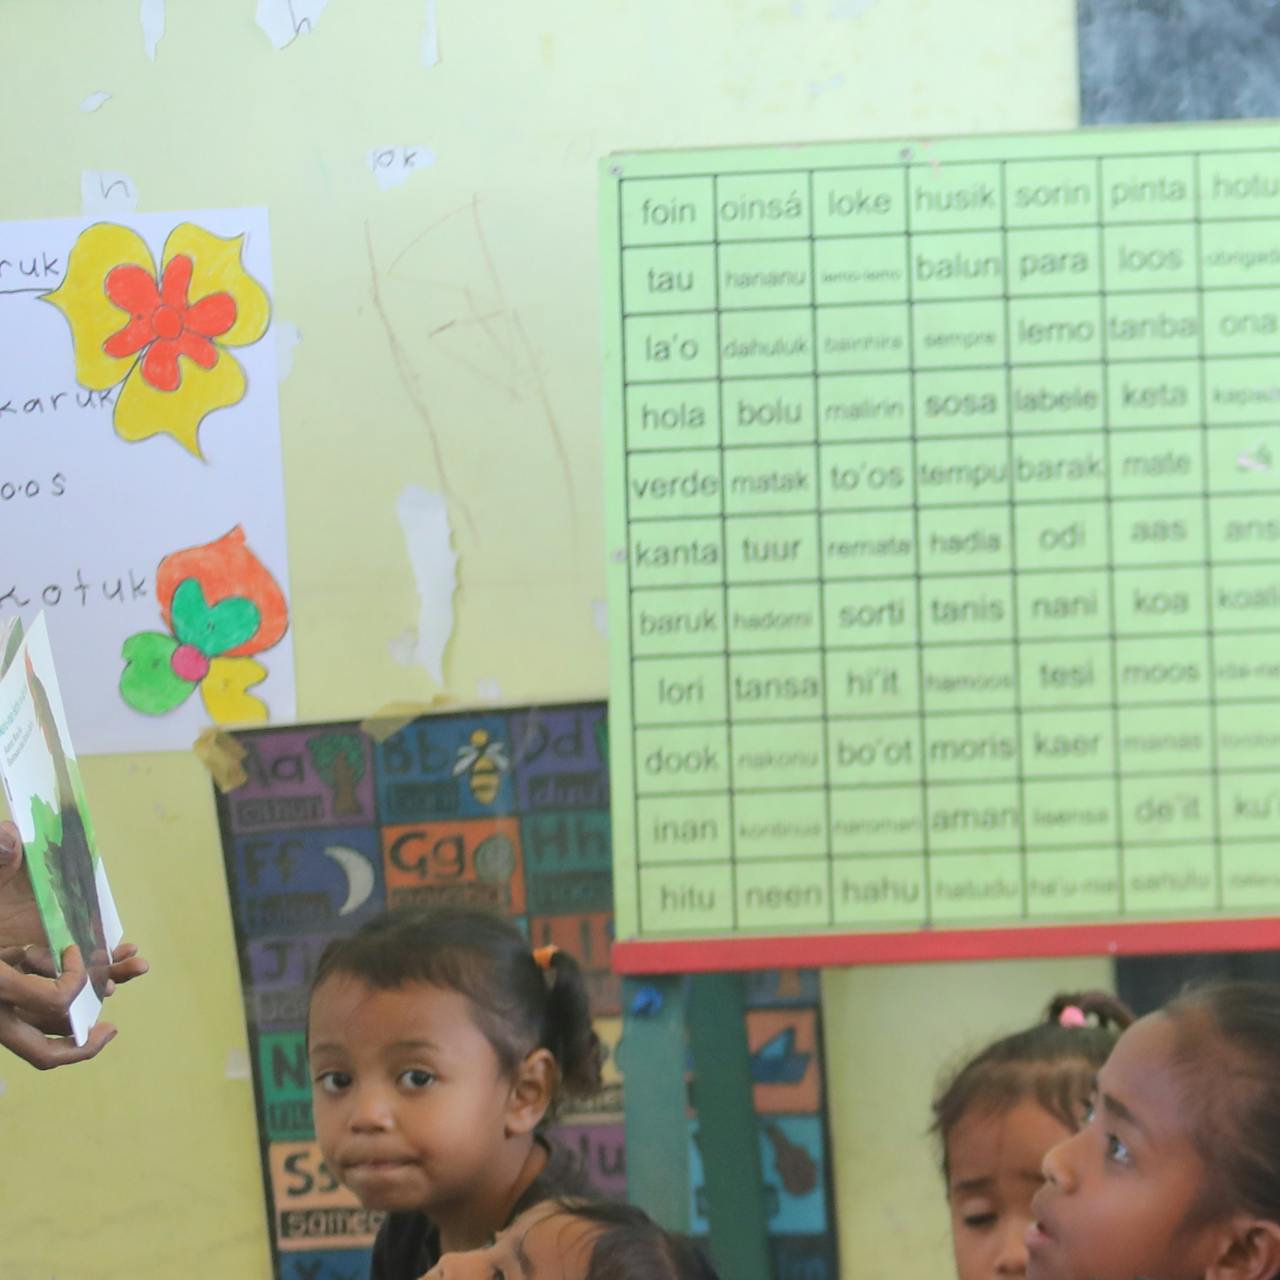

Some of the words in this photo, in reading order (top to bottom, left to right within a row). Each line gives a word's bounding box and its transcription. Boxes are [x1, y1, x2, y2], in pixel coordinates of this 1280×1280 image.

[642, 198, 695, 224] foin
[828, 189, 891, 215] loke
[915, 184, 1000, 211] husik
[1015, 183, 1092, 207] sorin
[1111, 177, 1187, 207] pinta
[1212, 172, 1280, 199] hotu
[647, 268, 693, 292] tau
[916, 251, 1002, 280] balun
[1019, 251, 1090, 280] para
[1118, 245, 1183, 271] loos
[1018, 316, 1094, 344] lemo
[1109, 313, 1197, 340] tanba
[1219, 313, 1278, 336] ona
[642, 402, 704, 429] hola
[737, 398, 801, 426] bolu
[924, 393, 997, 416] sosa
[1121, 382, 1189, 407] keta
[632, 471, 719, 498] verde
[731, 470, 808, 493] matak
[920, 463, 1007, 488] tempu
[1016, 453, 1104, 482] barak
[1121, 449, 1191, 477] mate
[635, 540, 717, 567] kanta
[742, 534, 801, 562] tuur
[1038, 521, 1087, 550] odi
[640, 608, 722, 635] baruk
[839, 600, 905, 627] sorti
[930, 595, 1004, 624] tanis
[1031, 593, 1099, 618] nani
[1132, 587, 1191, 615] koa
[657, 677, 705, 704] lori
[734, 677, 820, 701] tansa
[1039, 661, 1096, 688] tesi
[1122, 663, 1200, 684] moos
[645, 745, 718, 774] dook
[929, 736, 1015, 762] moris
[1033, 731, 1102, 757] kaer
[653, 819, 717, 843] inan
[931, 806, 1017, 832] aman
[390, 832, 466, 879] Gg
[660, 884, 714, 911] hitu
[745, 885, 821, 909] neen
[841, 876, 919, 903] hahu
